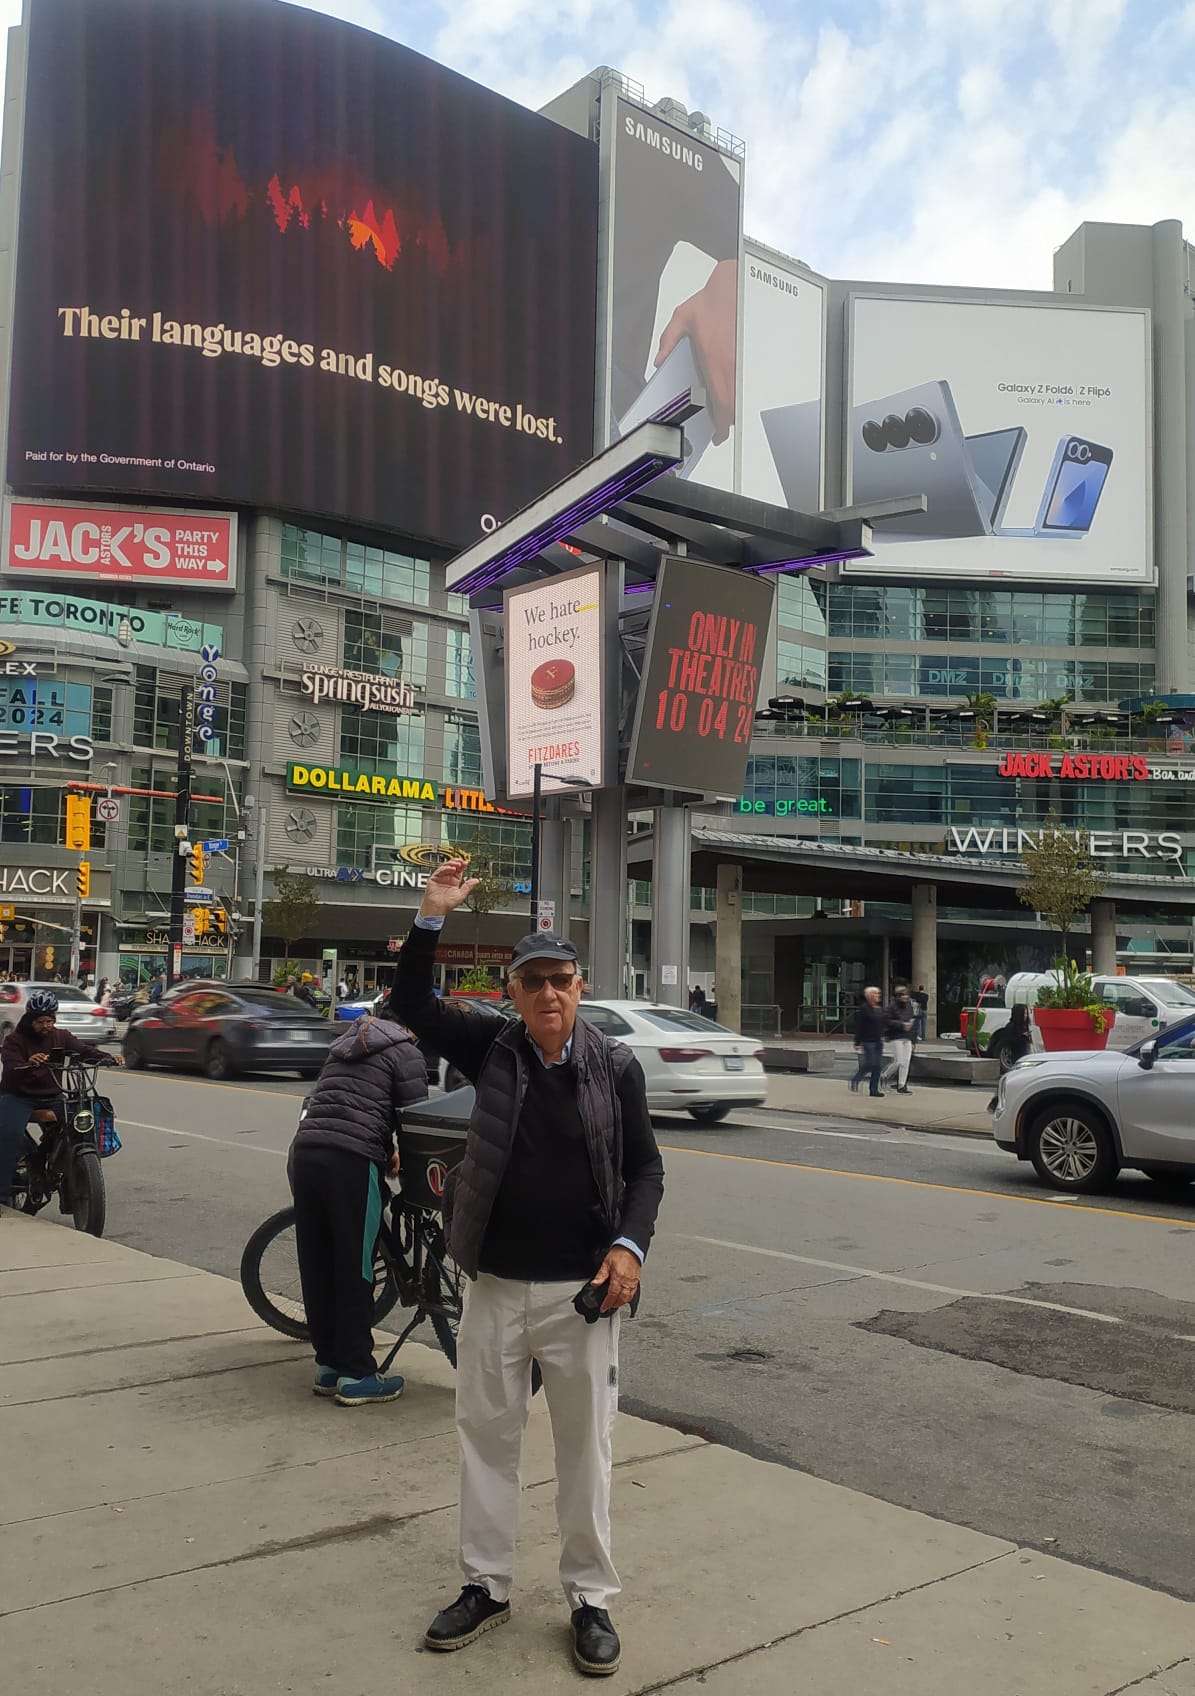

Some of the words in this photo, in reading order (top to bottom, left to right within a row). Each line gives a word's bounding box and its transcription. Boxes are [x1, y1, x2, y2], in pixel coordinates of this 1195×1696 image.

[625, 117, 704, 171] SAMSUNG
[750, 266, 798, 296] SAMSUNG
[57, 306, 147, 340] Their
[152, 311, 315, 367] languages
[320, 348, 373, 382] and
[378, 364, 450, 409] songs
[453, 388, 512, 427] were
[515, 404, 563, 444] lost.
[997, 383, 1036, 394] Galaxy
[1037, 385, 1044, 393] Z
[1045, 385, 1074, 395] Fold6
[1079, 386, 1086, 395] Z
[1087, 386, 1111, 398] Flip6
[1017, 396, 1045, 405] Galaxy
[1072, 398, 1091, 406] here
[25, 451, 47, 461] Paid
[49, 452, 64, 461] for
[66, 452, 78, 463] by
[81, 452, 97, 462] the
[100, 453, 162, 467] Government
[164, 458, 176, 468] of
[177, 460, 216, 473] Ontario
[100, 525, 112, 566] ASTORS
[175, 529, 219, 544] PARTY
[175, 543, 208, 556] THIS
[175, 557, 205, 571] WAY
[29, 598, 145, 633] TORONTO
[524, 605, 546, 627] We
[550, 598, 581, 621] hate
[528, 626, 581, 651] hockey.
[688, 610, 740, 659] ONLY
[739, 622, 758, 664] IN
[0, 662, 37, 676] EX
[303, 662, 339, 677] LOUNGE
[344, 669, 399, 688] RESTAURANT
[667, 647, 757, 705] THEATRES
[929, 671, 968, 685] DMZ
[198, 643, 219, 741] Yonge
[1056, 674, 1096, 689] DMZ
[0, 708, 64, 727] 2024
[656, 689, 688, 732] 10
[697, 698, 729, 740] 04
[184, 692, 194, 762] DOWNTOWN
[528, 740, 580, 763] FITZDARES
[1000, 752, 1054, 778] JACK
[1060, 753, 1149, 781] ASTOR'S
[292, 765, 435, 801] DOLLARAMA
[740, 794, 766, 813] be
[776, 797, 833, 817] great.
[306, 866, 336, 878] ULTRA
[376, 869, 428, 888] CINE
[146, 932, 169, 945] SHA
